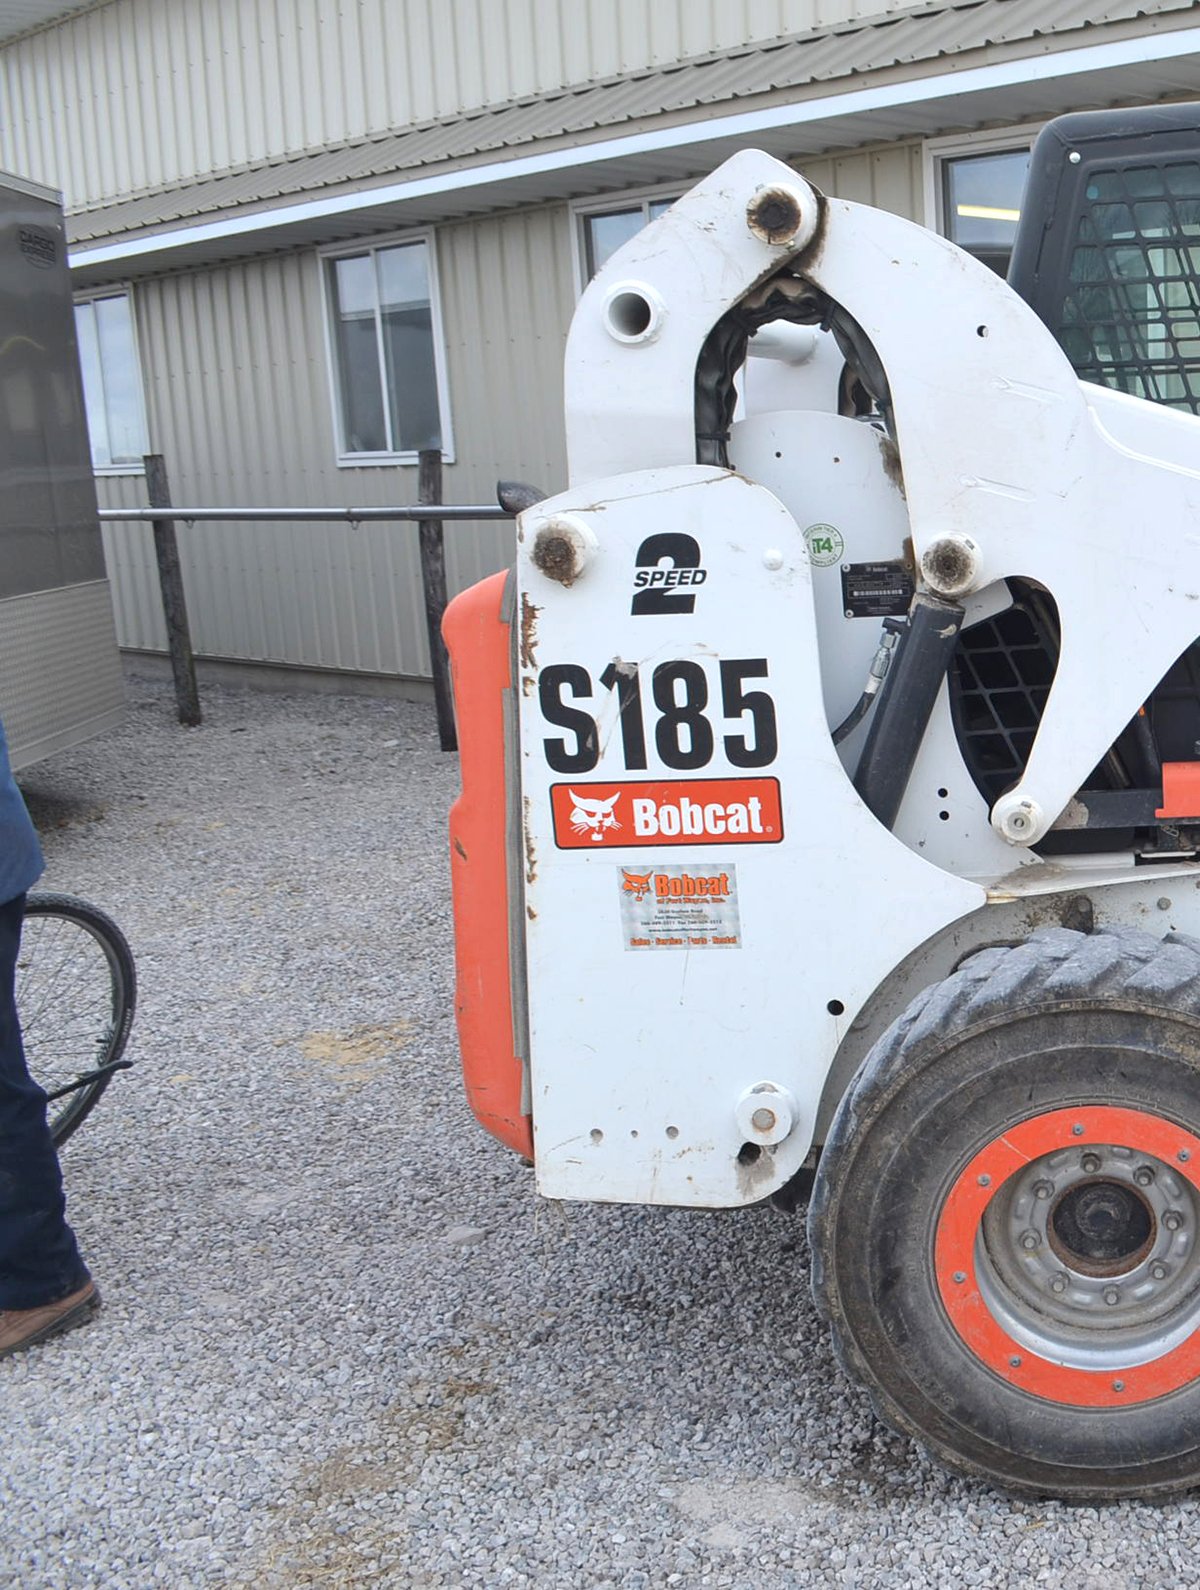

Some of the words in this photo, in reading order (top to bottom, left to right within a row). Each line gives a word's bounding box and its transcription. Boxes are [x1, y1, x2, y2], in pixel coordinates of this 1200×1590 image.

[20, 230, 55, 252] CARGO
[631, 532, 701, 616] 2
[633, 569, 707, 587] SPEED
[538, 658, 778, 774] S185
[632, 797, 764, 836] Bobcat
[654, 873, 729, 897] Bobcat
